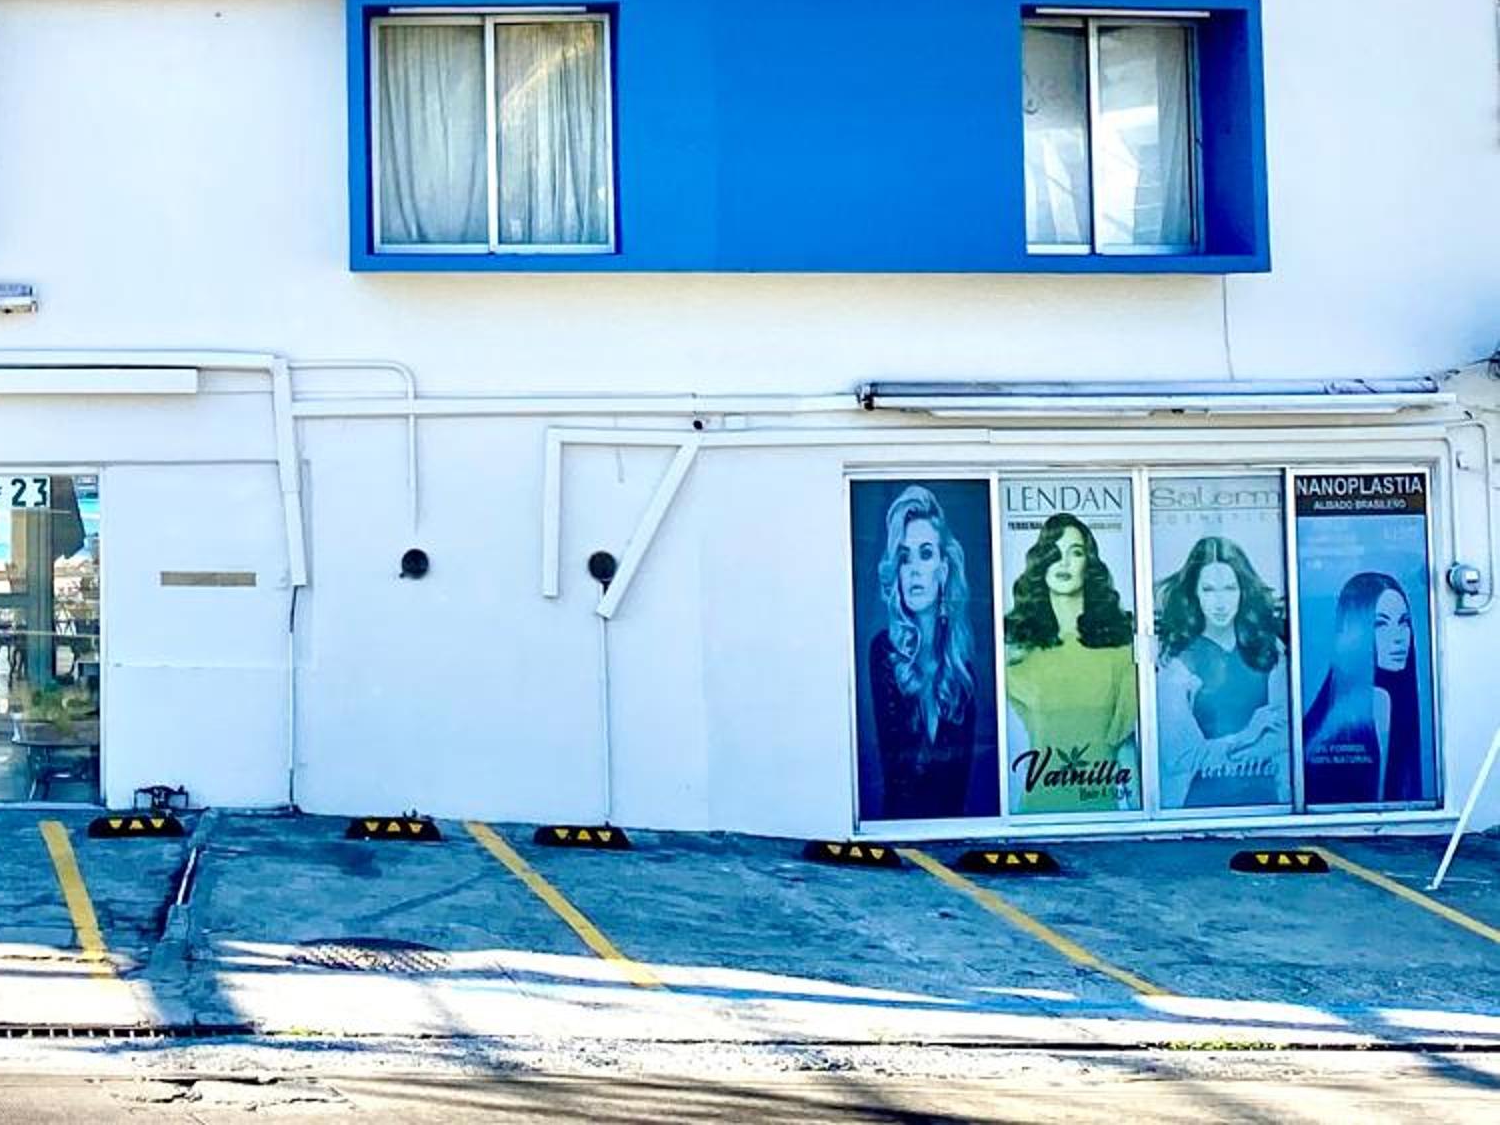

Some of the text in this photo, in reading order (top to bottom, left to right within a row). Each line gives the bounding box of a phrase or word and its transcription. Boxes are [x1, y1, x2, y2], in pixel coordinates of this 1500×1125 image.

[1297, 476, 1423, 495] NANOPLASTIA
[1006, 486, 1123, 511] LENDAN
[1011, 746, 1132, 793] Vainilla
